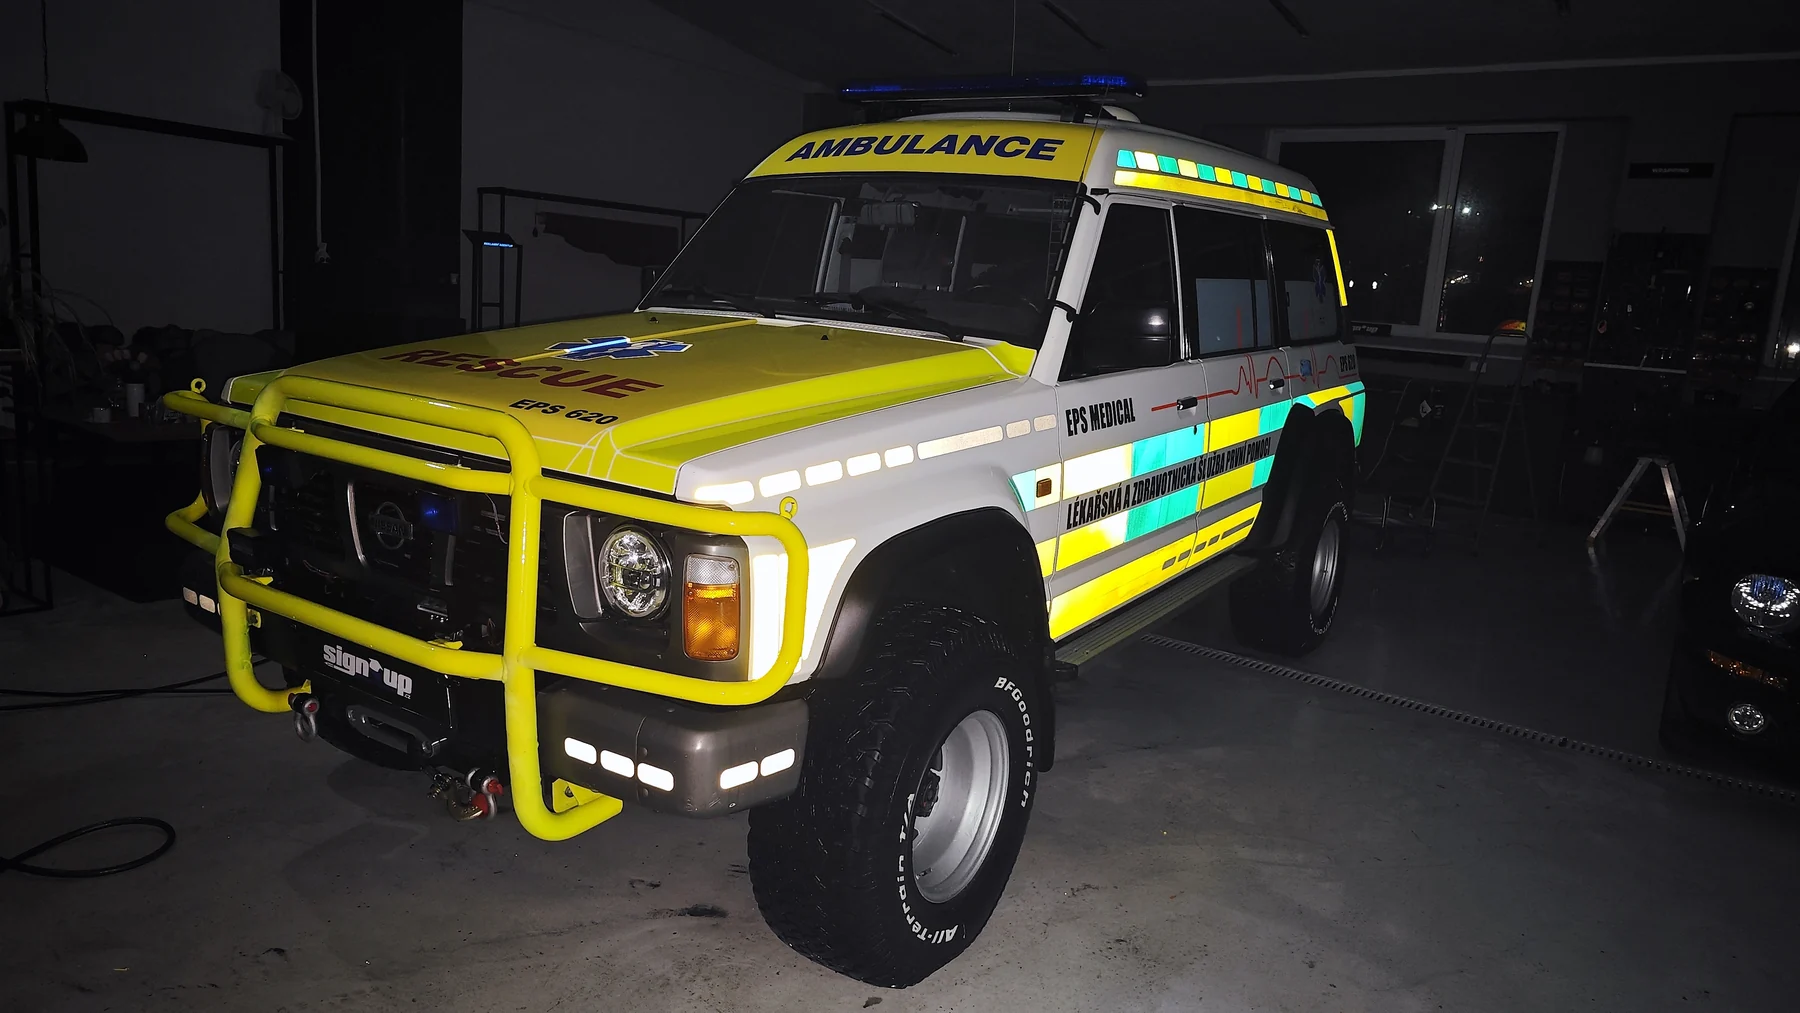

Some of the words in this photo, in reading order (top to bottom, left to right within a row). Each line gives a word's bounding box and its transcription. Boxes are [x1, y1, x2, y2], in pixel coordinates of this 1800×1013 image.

[784, 134, 1065, 162] AMBULANCE
[379, 349, 664, 399] RESCUE
[508, 398, 566, 415] EPS
[565, 408, 619, 425] 620
[1065, 406, 1088, 437] EPS
[1089, 397, 1136, 431] MEDICAL
[1066, 482, 1122, 530] LÉKAŘSKÁ
[1122, 484, 1131, 510] A
[1131, 457, 1197, 506] ZDRAVOTNICKÁ
[1225, 440, 1247, 471] PRVNÍ
[1246, 436, 1271, 464] POMOCI
[323, 644, 369, 677] sign
[383, 667, 412, 697] up
[994, 676, 1034, 808] BFGoodrich
